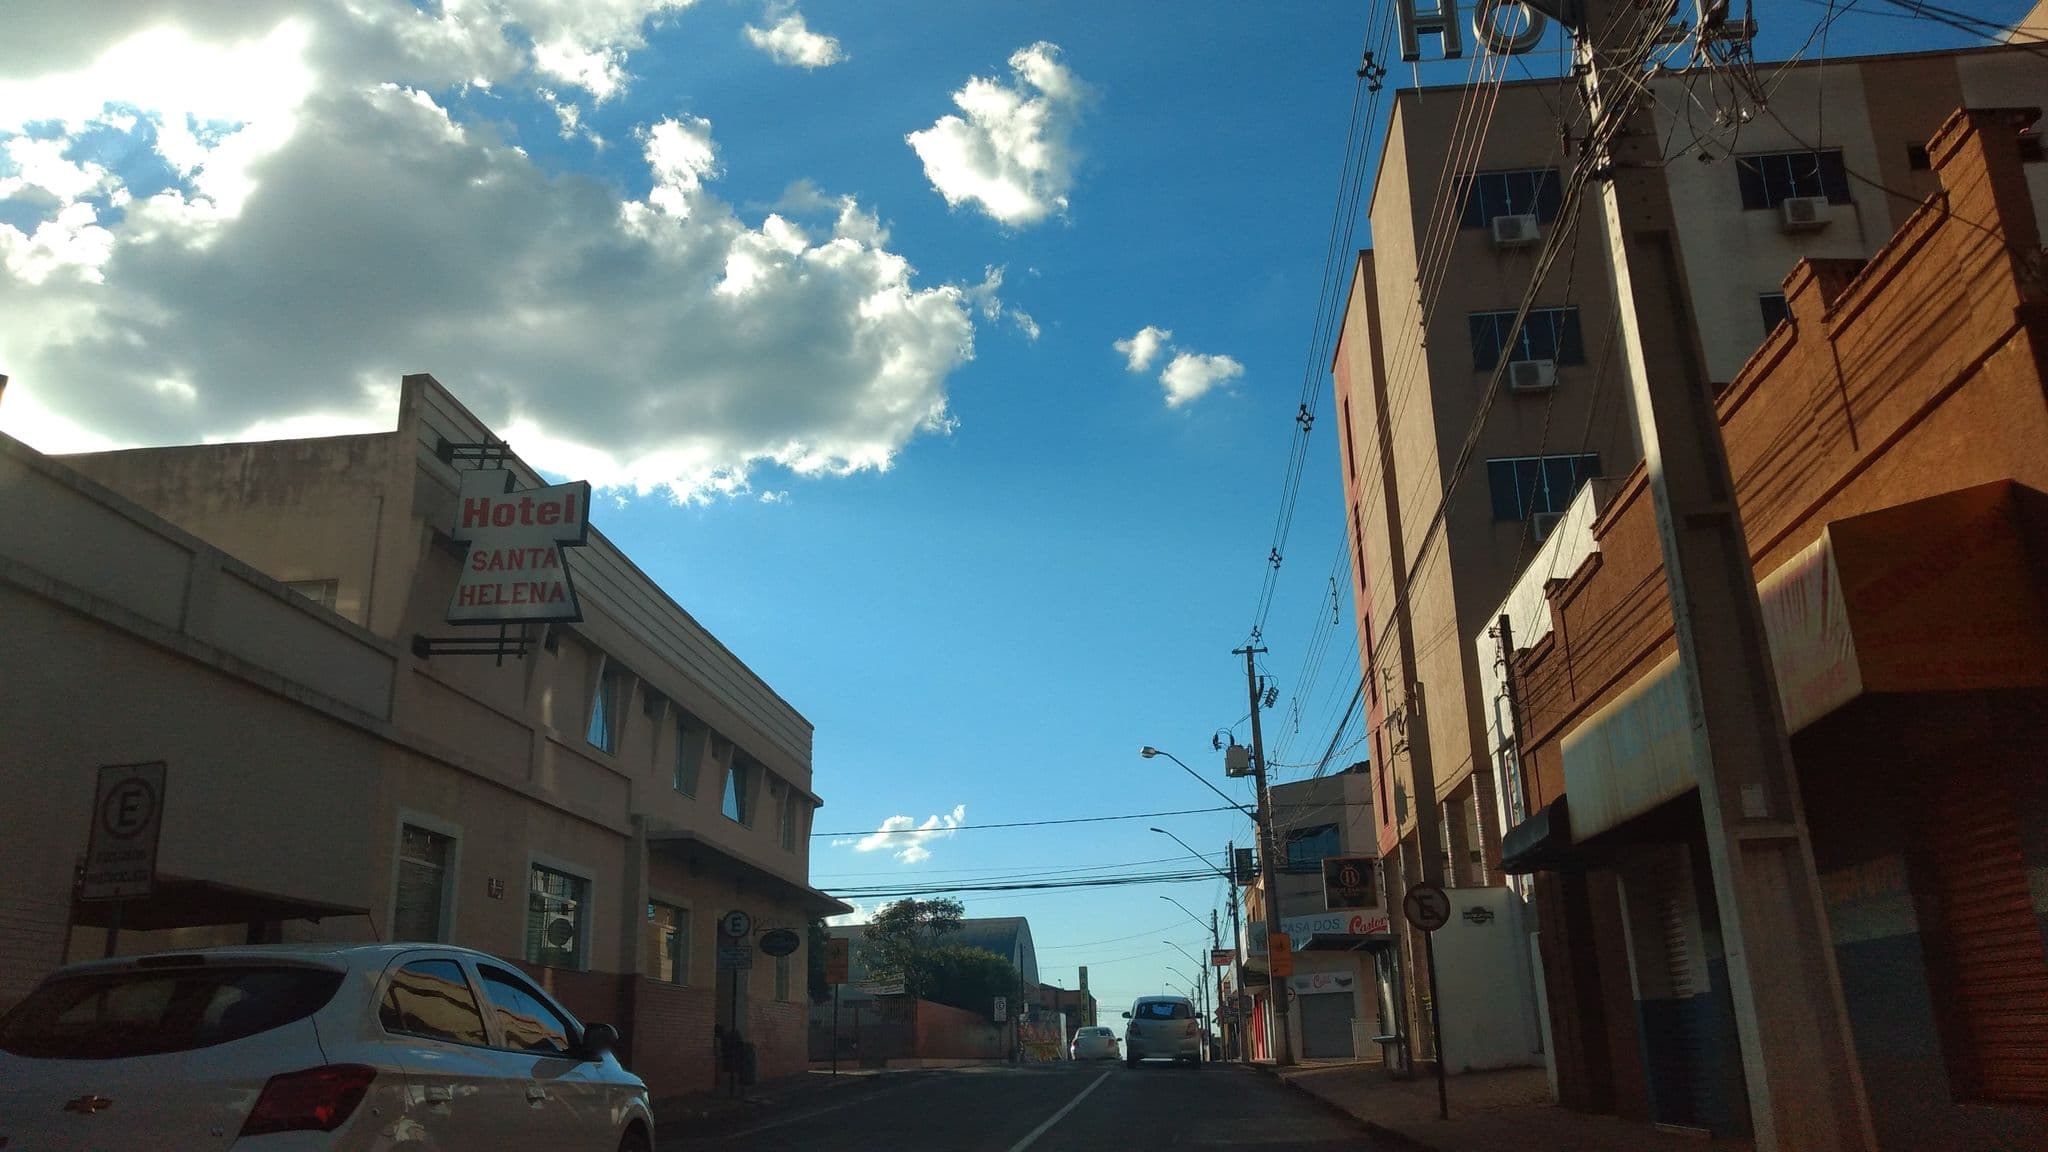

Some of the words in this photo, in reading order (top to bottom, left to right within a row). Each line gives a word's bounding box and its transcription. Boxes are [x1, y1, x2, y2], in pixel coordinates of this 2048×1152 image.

[463, 494, 576, 528] Hotel
[472, 548, 560, 571] SANTA
[459, 582, 566, 607] HELENA
[119, 791, 141, 826] E
[731, 916, 742, 932] E
[1314, 919, 1340, 931] DOS
